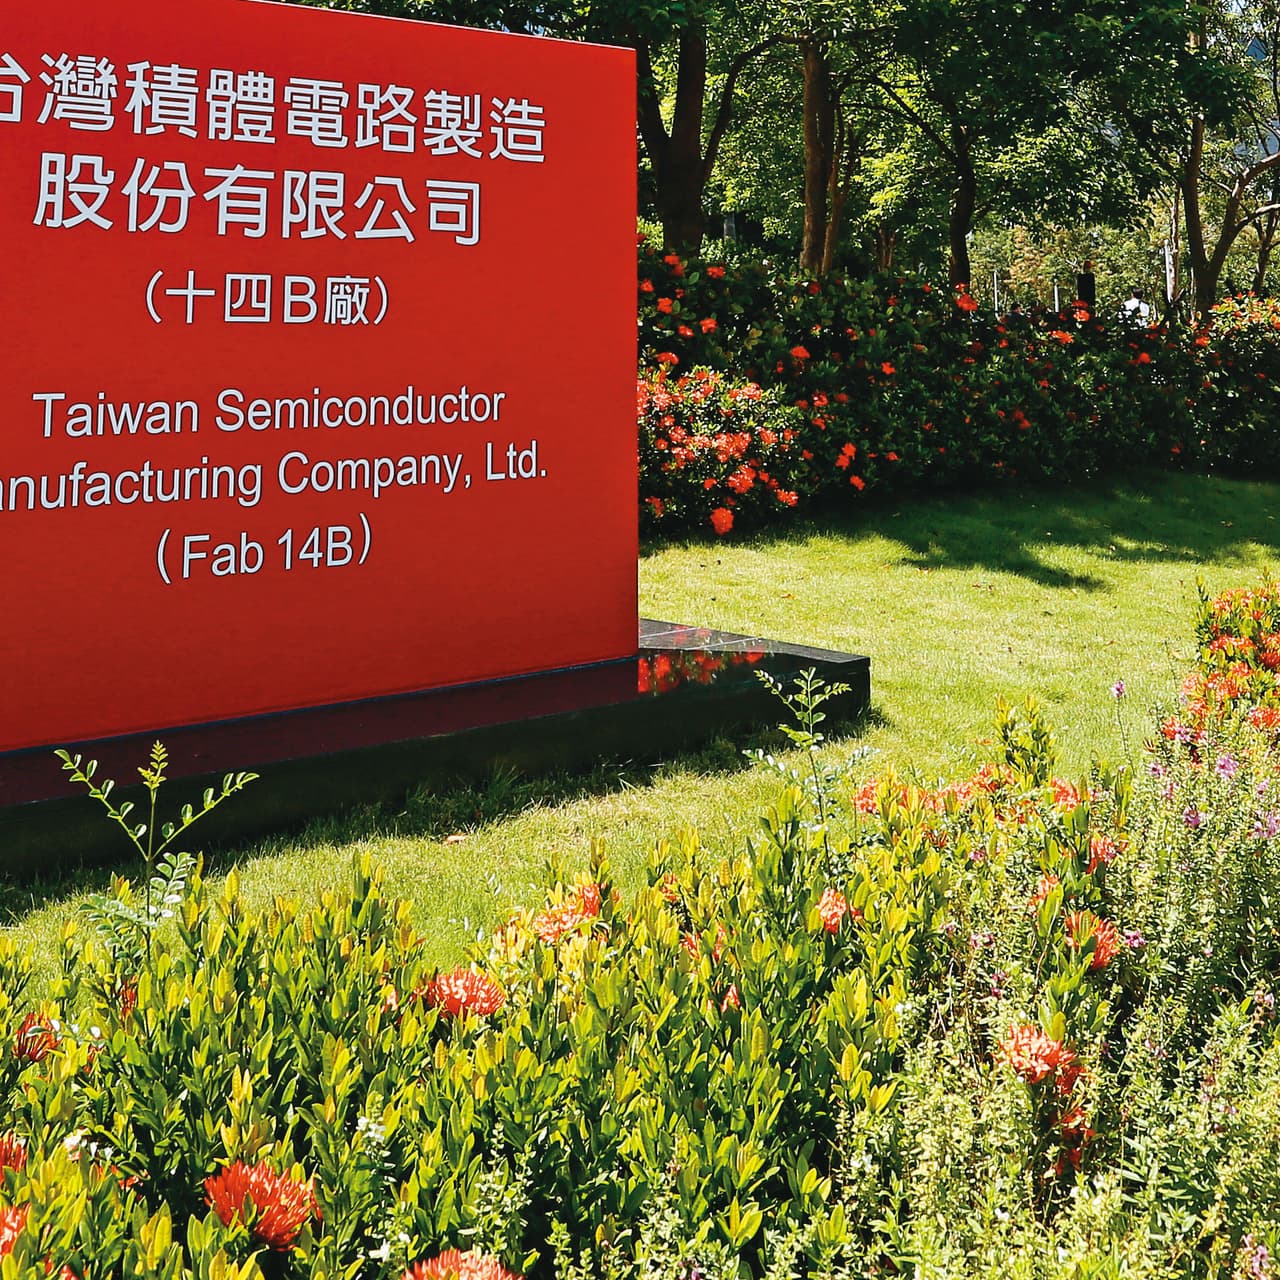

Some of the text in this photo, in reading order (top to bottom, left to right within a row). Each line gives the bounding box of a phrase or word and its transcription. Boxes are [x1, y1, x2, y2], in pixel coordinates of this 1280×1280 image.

[32, 152, 481, 246] 股份有限公司
[32, 385, 506, 438] Taiwan Semiconductor
[278, 451, 472, 499] Company,
[486, 439, 547, 481] Ltd.
[157, 512, 372, 584] (Fab 14B)
